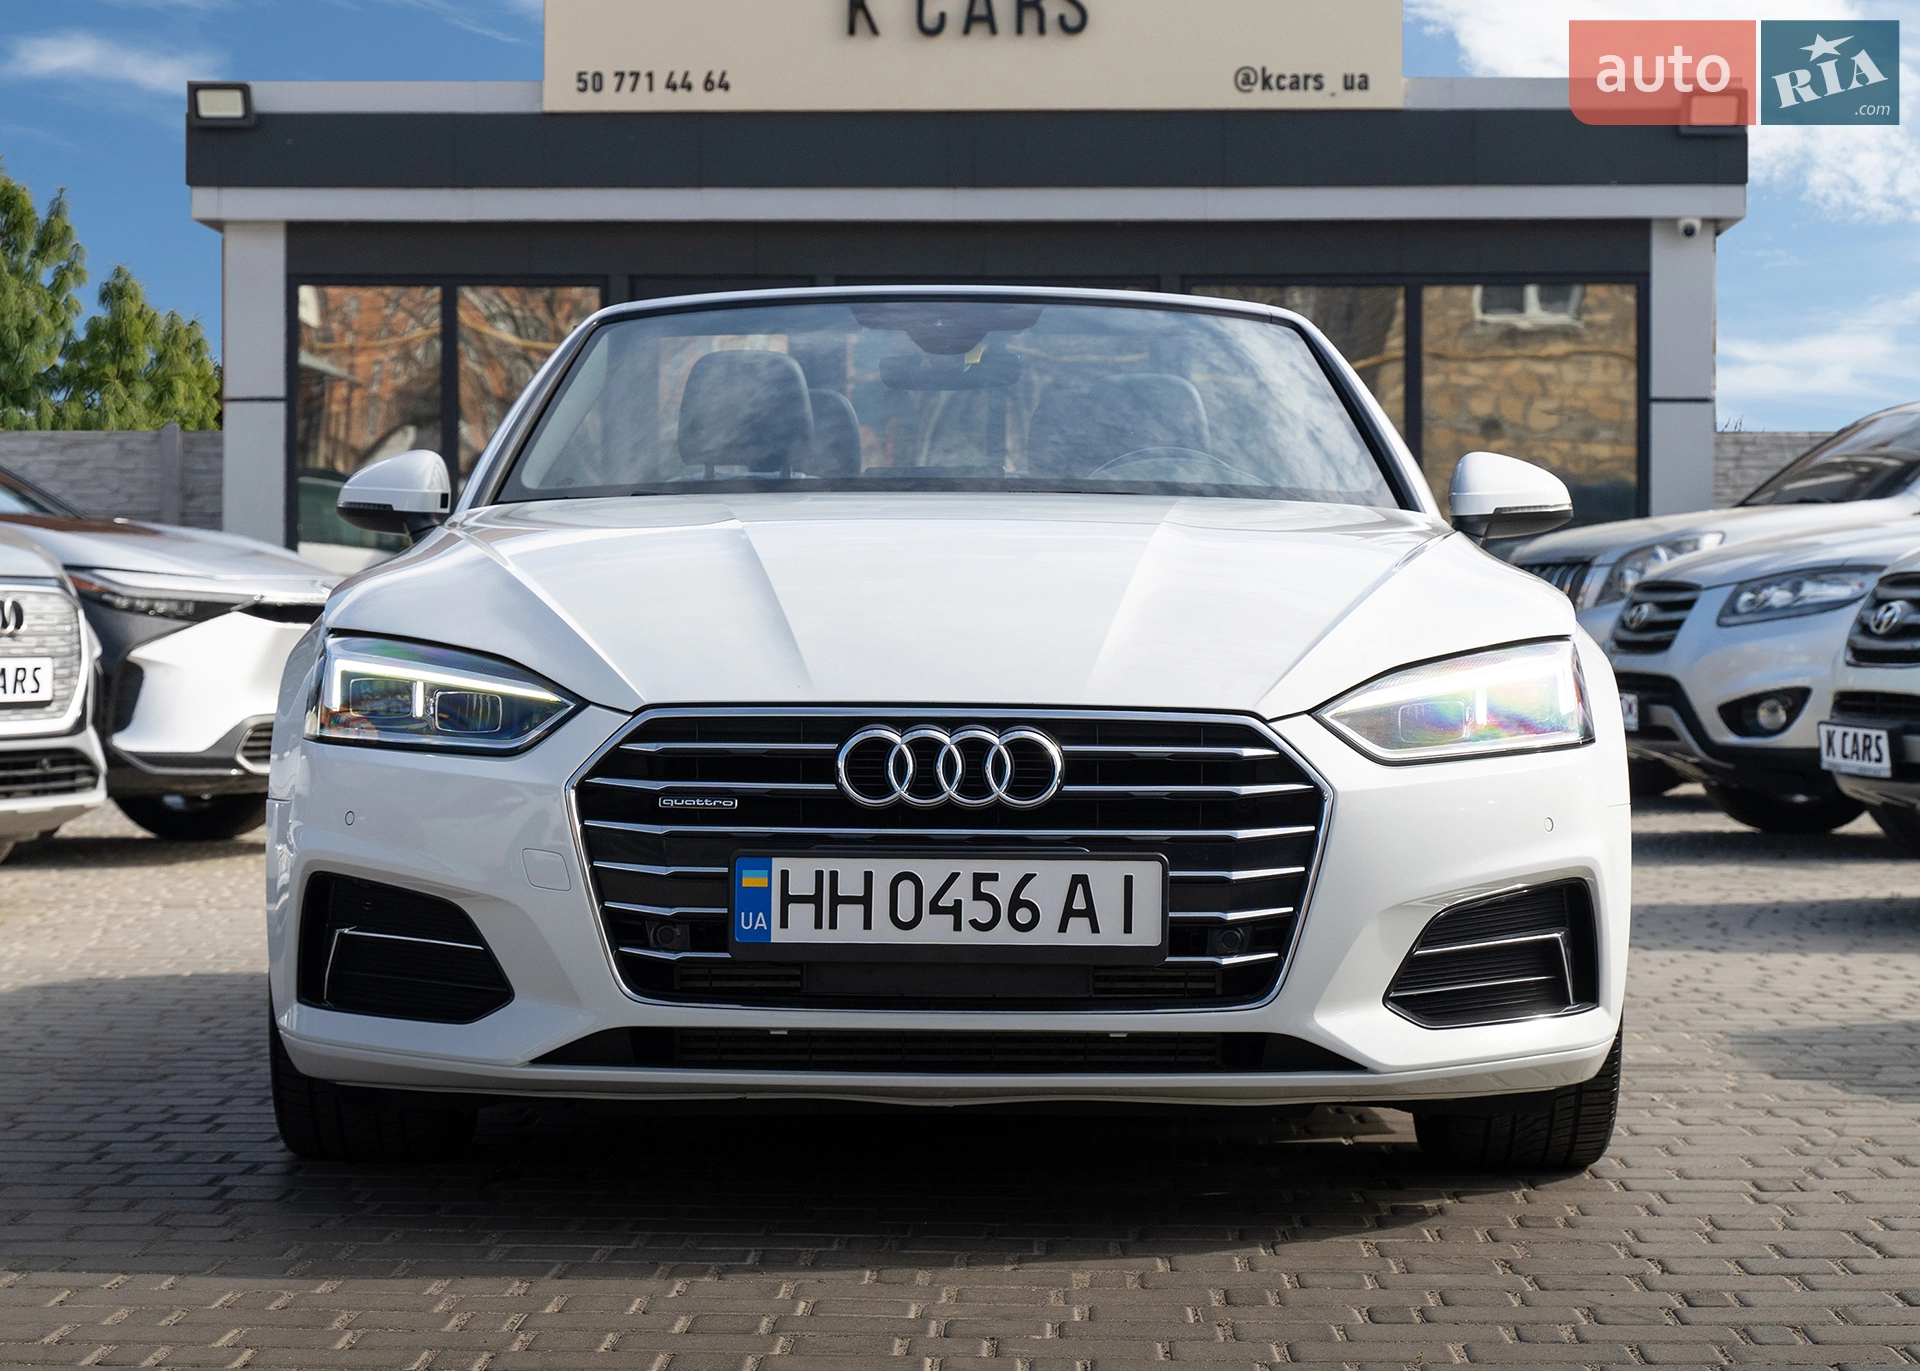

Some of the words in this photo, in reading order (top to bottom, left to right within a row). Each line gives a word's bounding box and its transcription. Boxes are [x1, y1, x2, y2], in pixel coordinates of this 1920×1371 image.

[576, 71, 603, 92] 50
[613, 71, 654, 92] 771
[664, 71, 693, 92] 44
[703, 71, 730, 92] 64
[1826, 729, 1836, 757] K
[1841, 731, 1883, 763] CARS
[662, 798, 734, 807] quattro
[779, 868, 873, 930] HH
[889, 870, 1041, 933] 0456
[740, 911, 767, 930] UA
